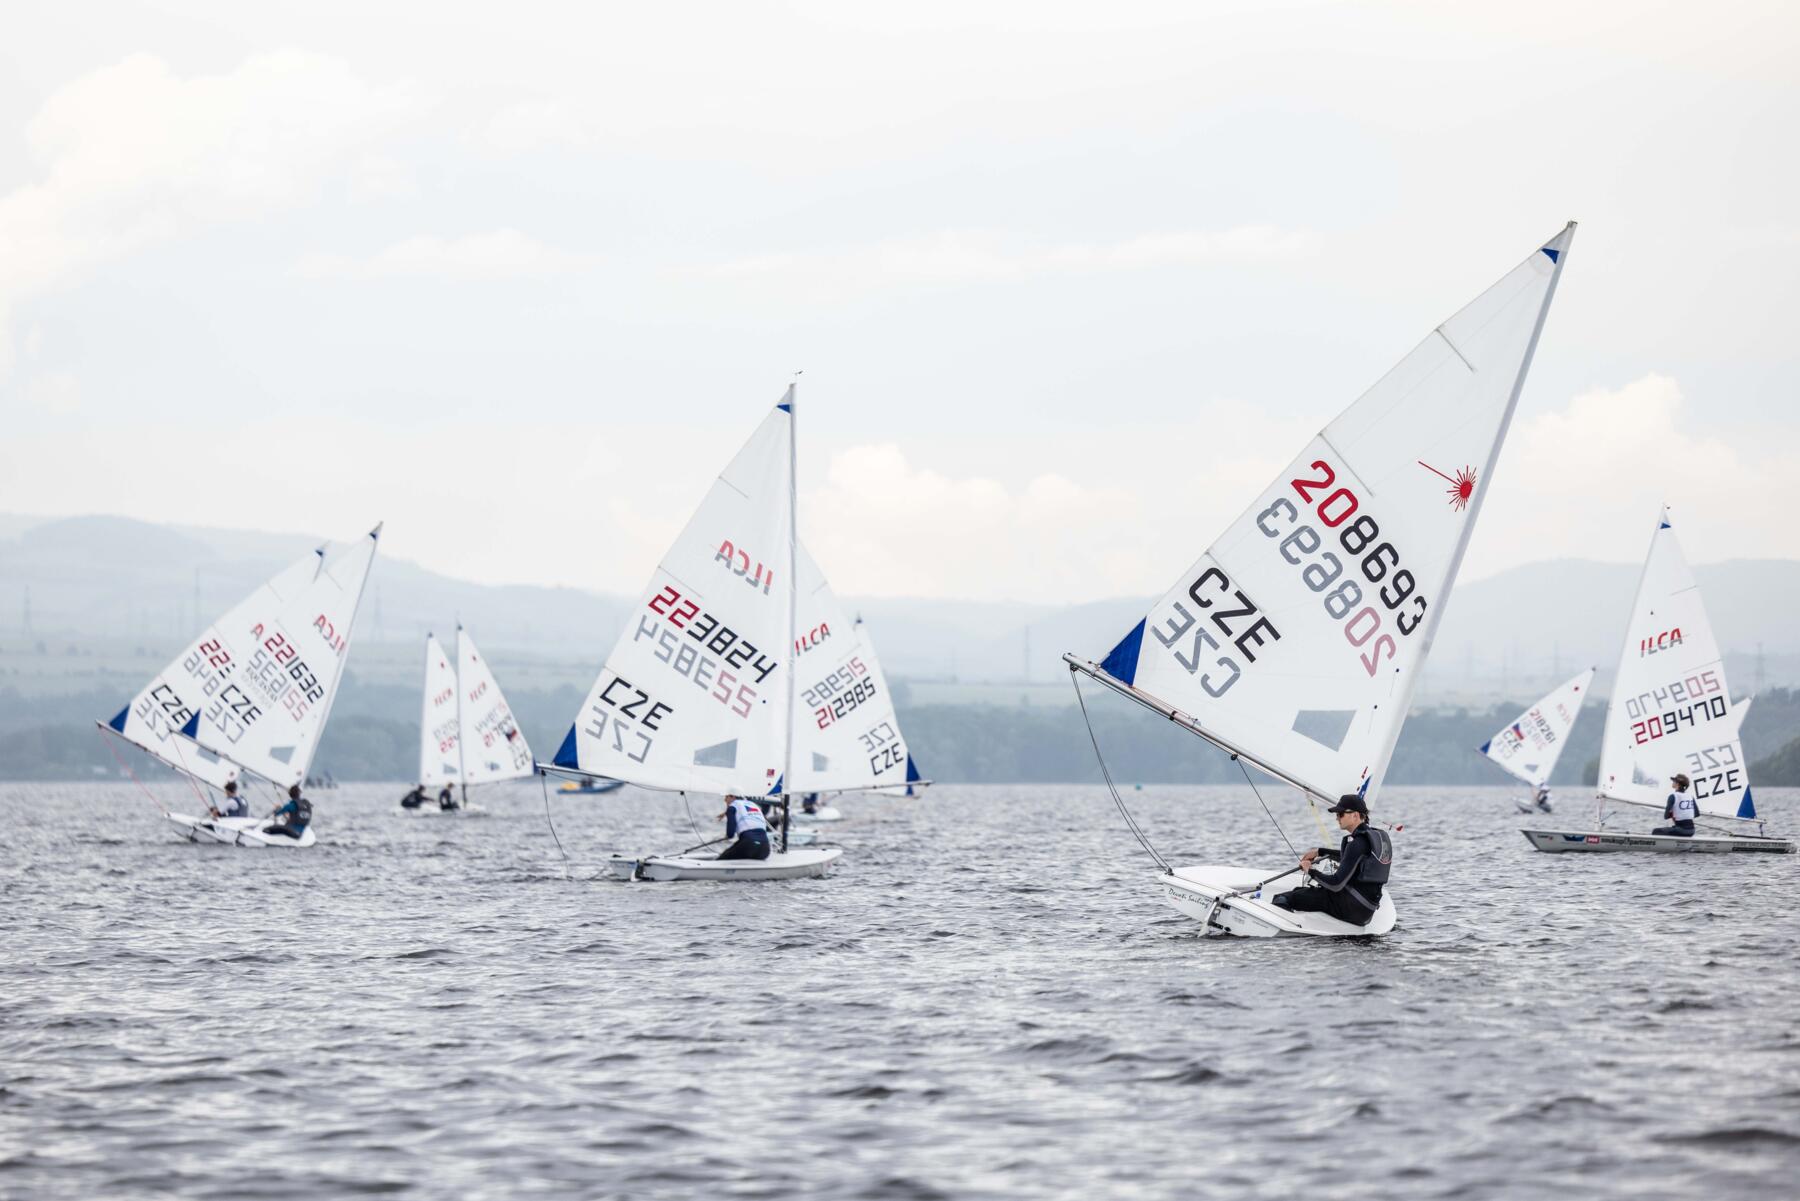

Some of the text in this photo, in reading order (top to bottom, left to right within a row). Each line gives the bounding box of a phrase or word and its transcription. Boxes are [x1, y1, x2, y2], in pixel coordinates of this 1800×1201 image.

[1291, 460, 1427, 636] 208693
[647, 585, 777, 684] 223824
[794, 623, 831, 656] ILCA
[1189, 567, 1281, 664] CZE
[1640, 627, 1683, 658] ILCA
[264, 632, 324, 704] 221632
[151, 684, 193, 725] CZE
[220, 684, 262, 726] CZE
[599, 677, 674, 731] CZE
[815, 676, 876, 730] 212985
[1632, 695, 1727, 745] 209470
[870, 742, 904, 776] CZE
[1693, 768, 1742, 800] CZE
